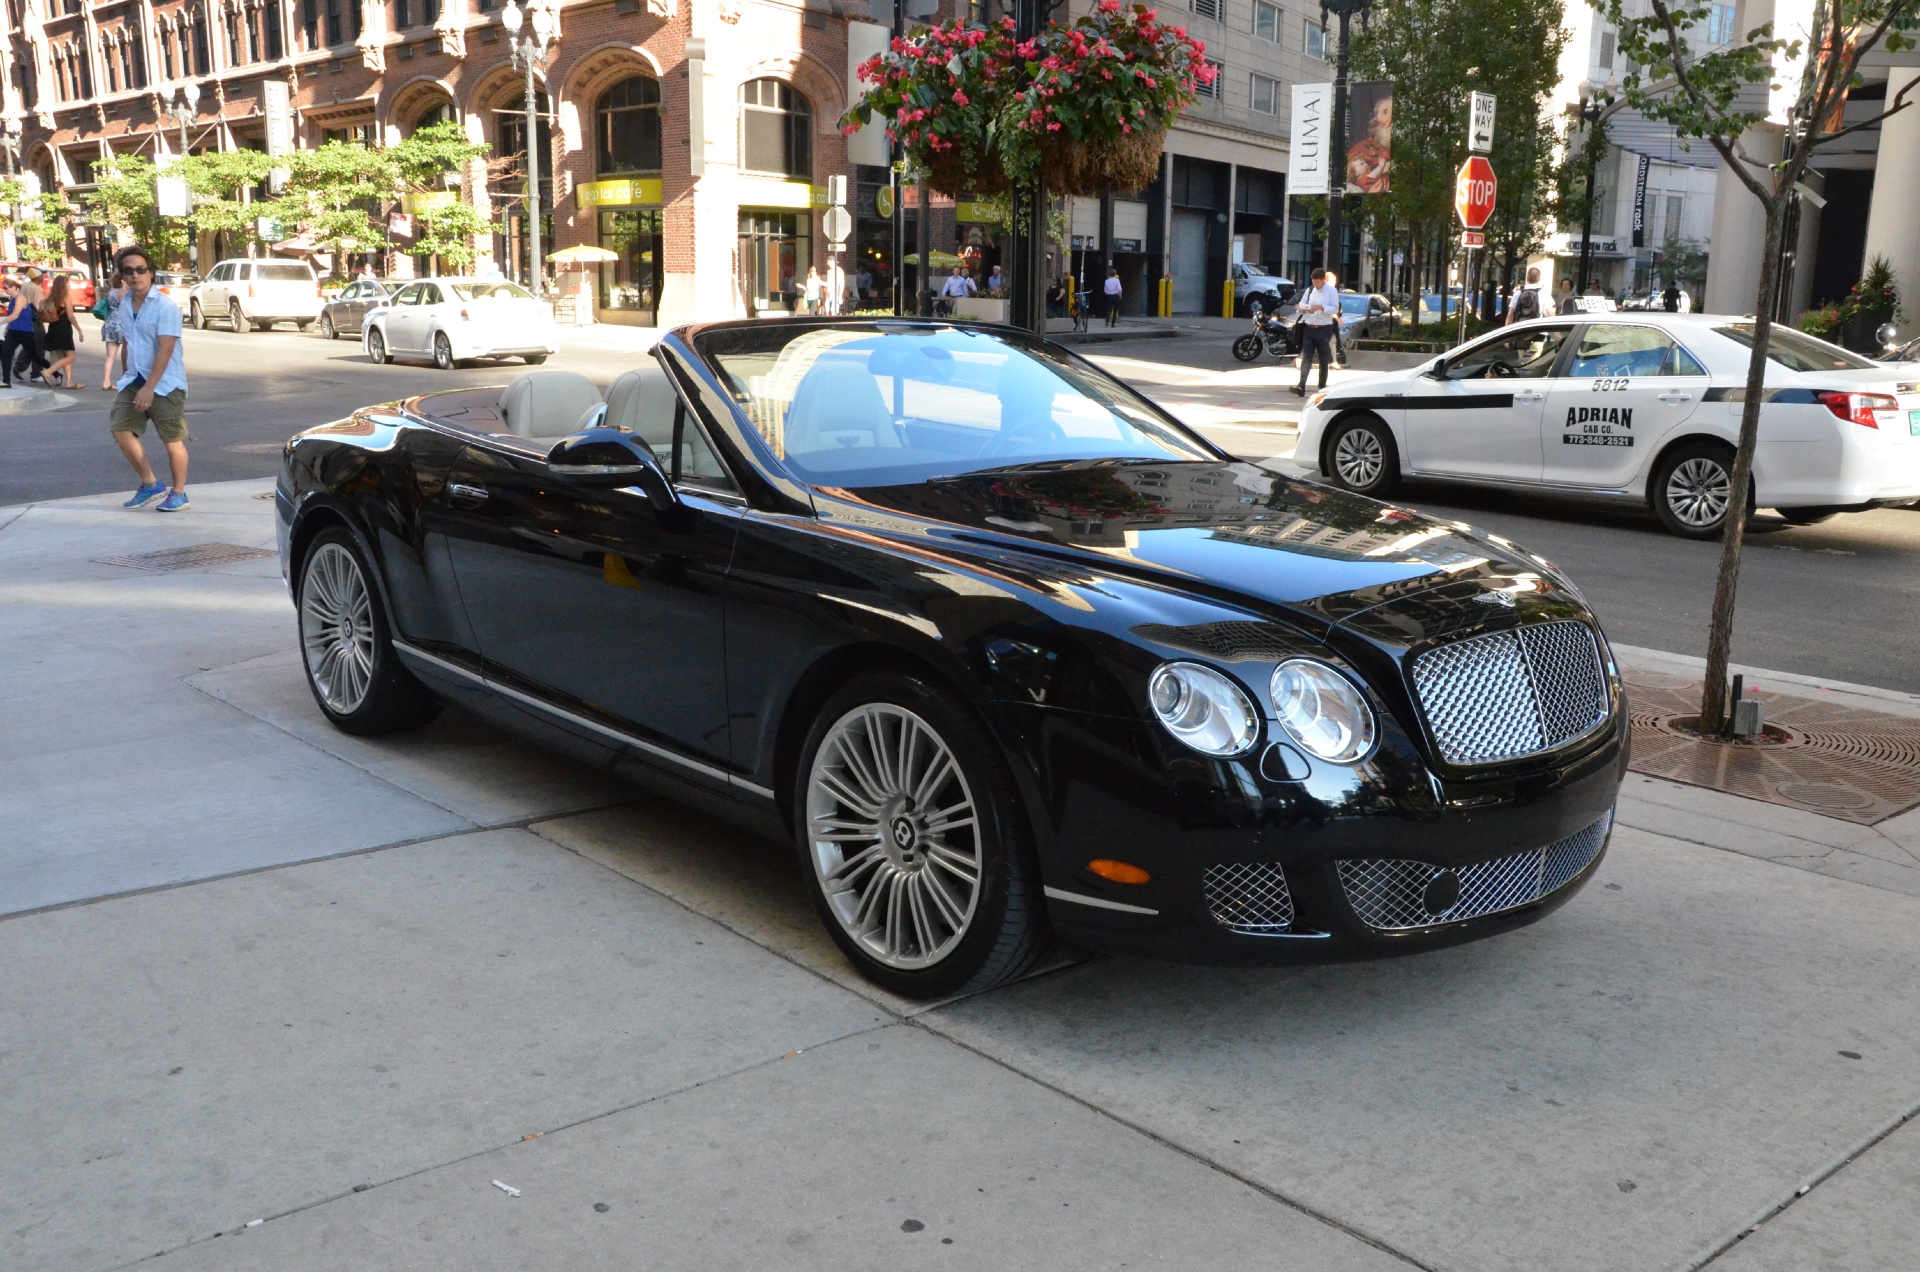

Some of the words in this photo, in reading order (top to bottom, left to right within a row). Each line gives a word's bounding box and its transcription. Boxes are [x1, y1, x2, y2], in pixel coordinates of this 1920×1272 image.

[1475, 98, 1493, 113] ONE
[1474, 113, 1492, 129] WAY
[1300, 98, 1320, 172] LUMA
[600, 187, 614, 200] tea
[615, 181, 643, 199] café
[1459, 178, 1494, 206] STOP
[1633, 208, 1643, 231] rack
[1602, 239, 1617, 252] rack
[1592, 379, 1630, 392] 5812
[1566, 407, 1633, 430] ADRIAN
[1583, 425, 1598, 434] CAB
[1601, 425, 1613, 434] CO.
[1568, 435, 1629, 446] 773-848-2521
